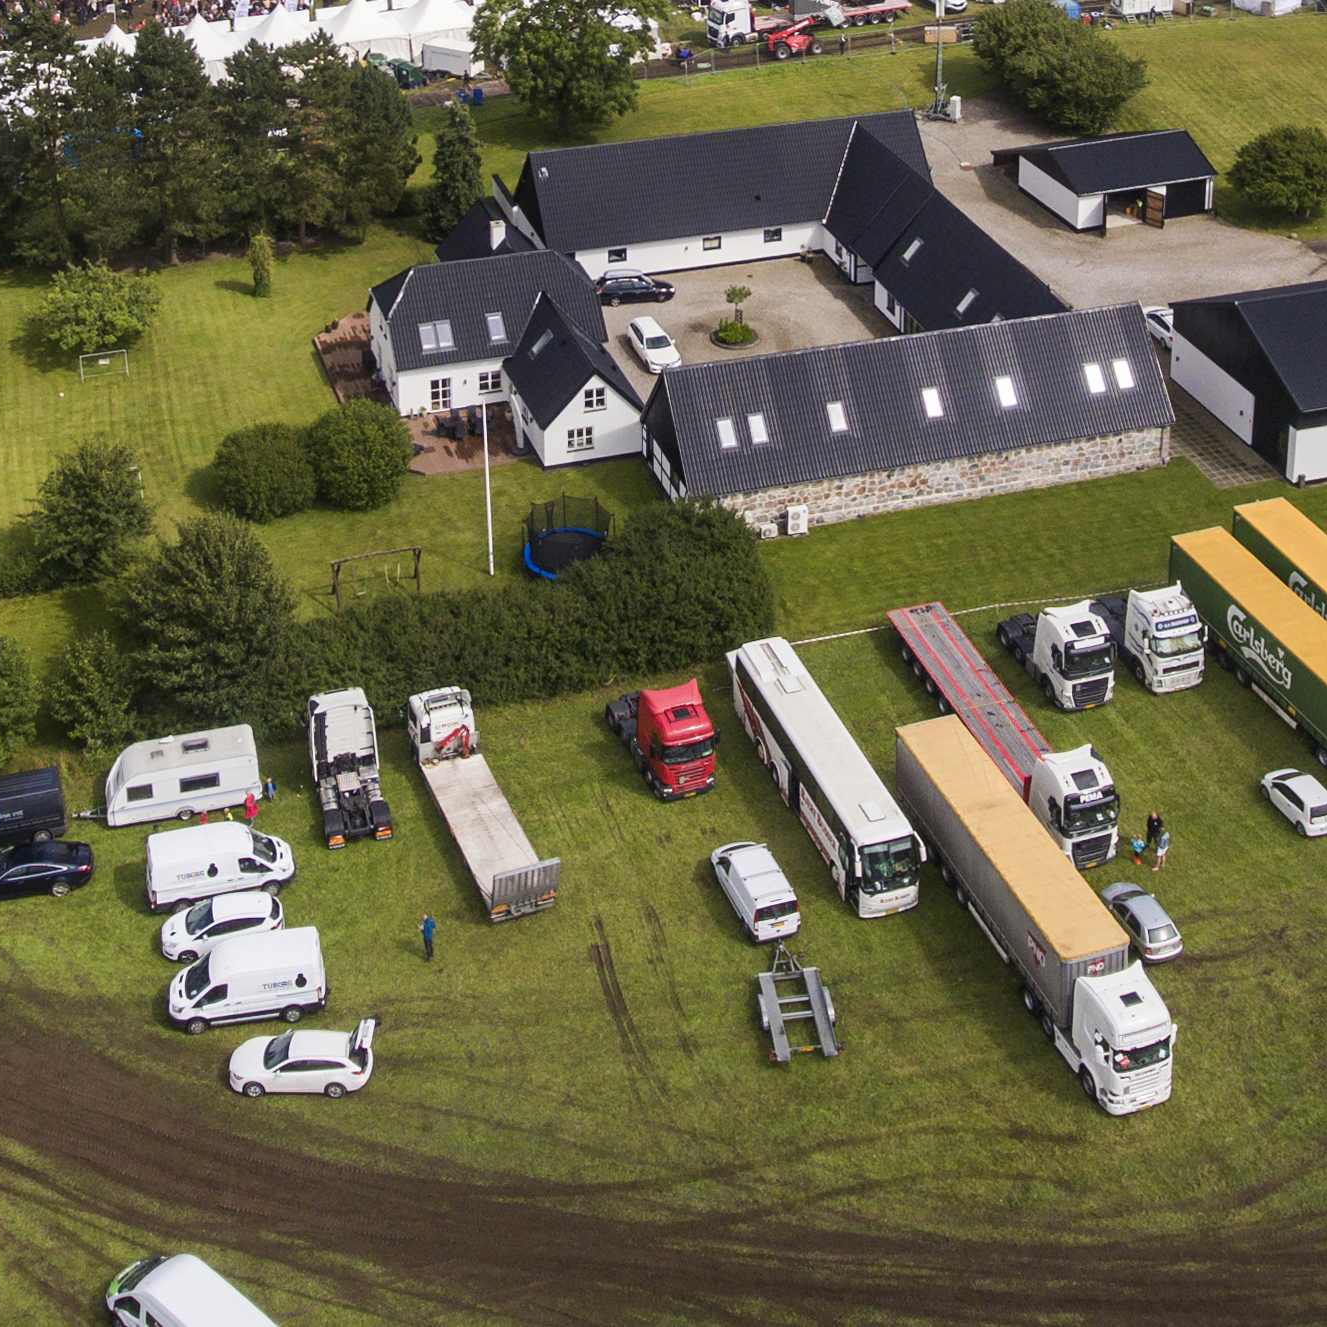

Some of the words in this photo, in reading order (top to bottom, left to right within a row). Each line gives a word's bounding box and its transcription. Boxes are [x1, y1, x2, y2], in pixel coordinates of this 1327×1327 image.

[1227, 604, 1292, 690] Carlsberg
[1079, 791, 1103, 804] PEMA
[176, 870, 205, 881] TUBORG
[1027, 934, 1047, 968] PNO
[1087, 961, 1105, 975] PNO
[262, 980, 293, 991] TUBORG
